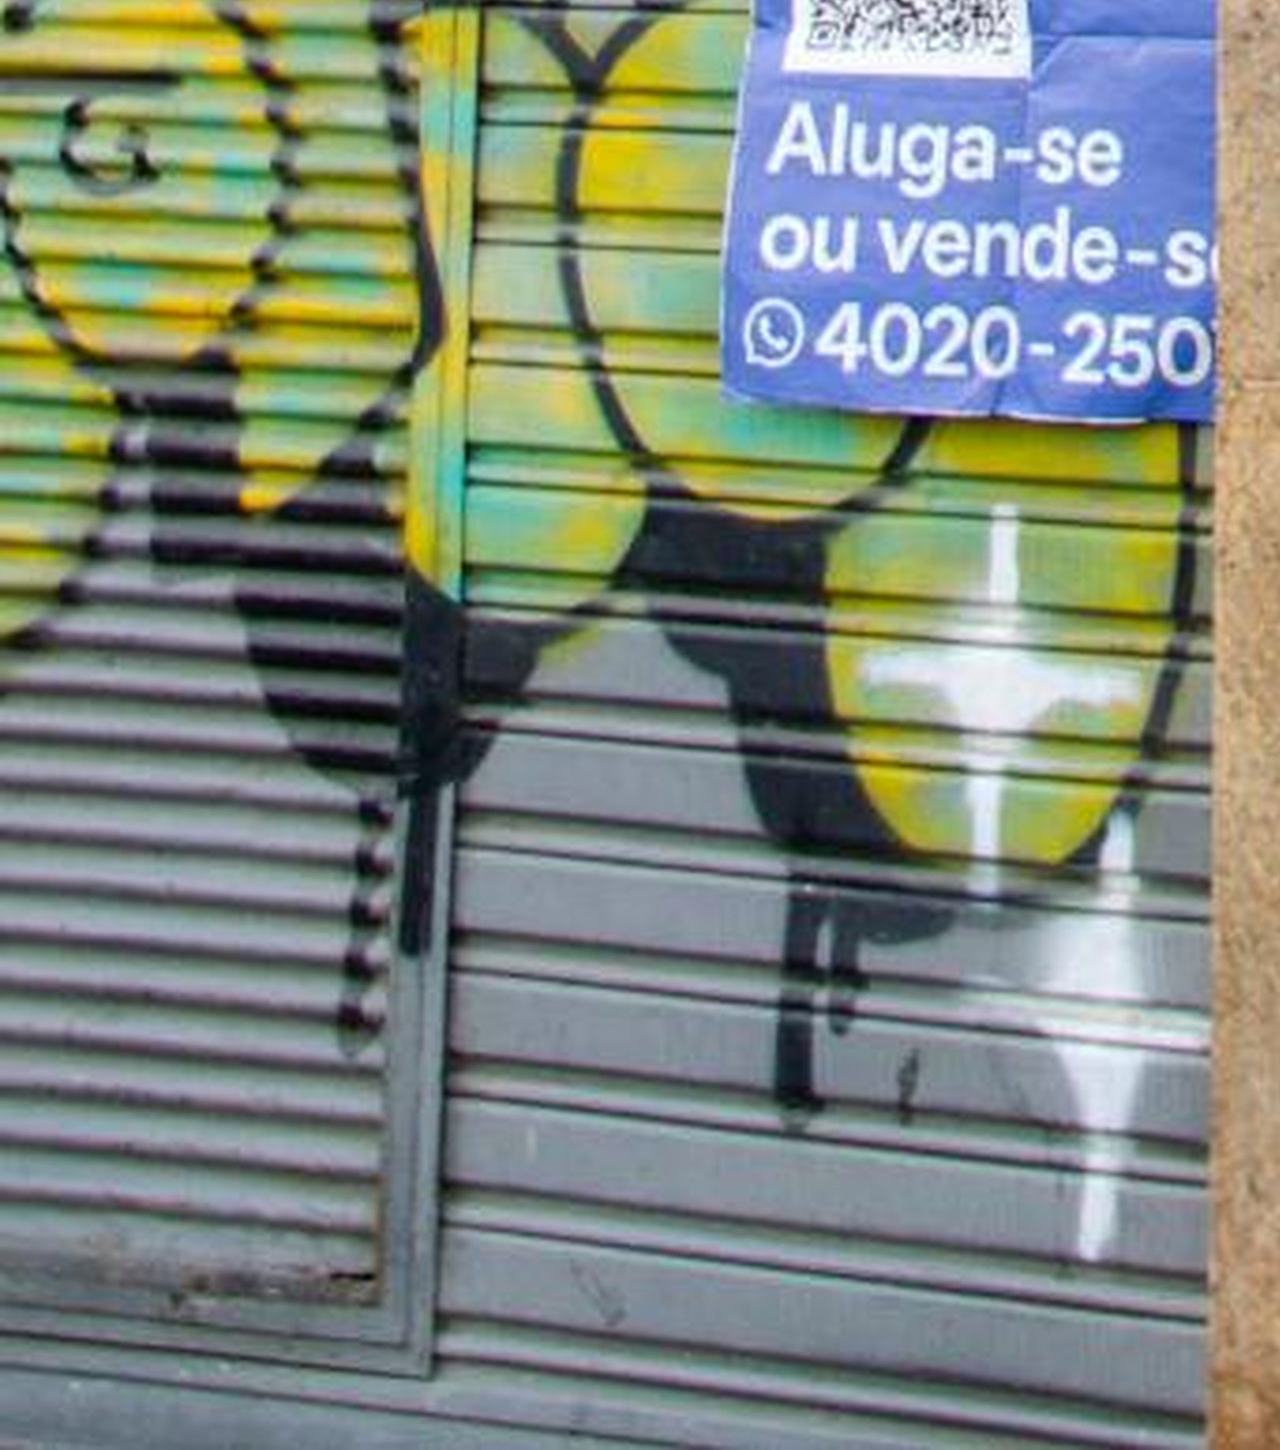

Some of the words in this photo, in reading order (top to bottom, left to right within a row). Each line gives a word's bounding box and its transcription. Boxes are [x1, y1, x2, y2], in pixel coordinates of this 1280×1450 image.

[765, 99, 1123, 200] Aluga-se
[759, 213, 860, 273] ou
[814, 302, 1220, 388] 4020-250
